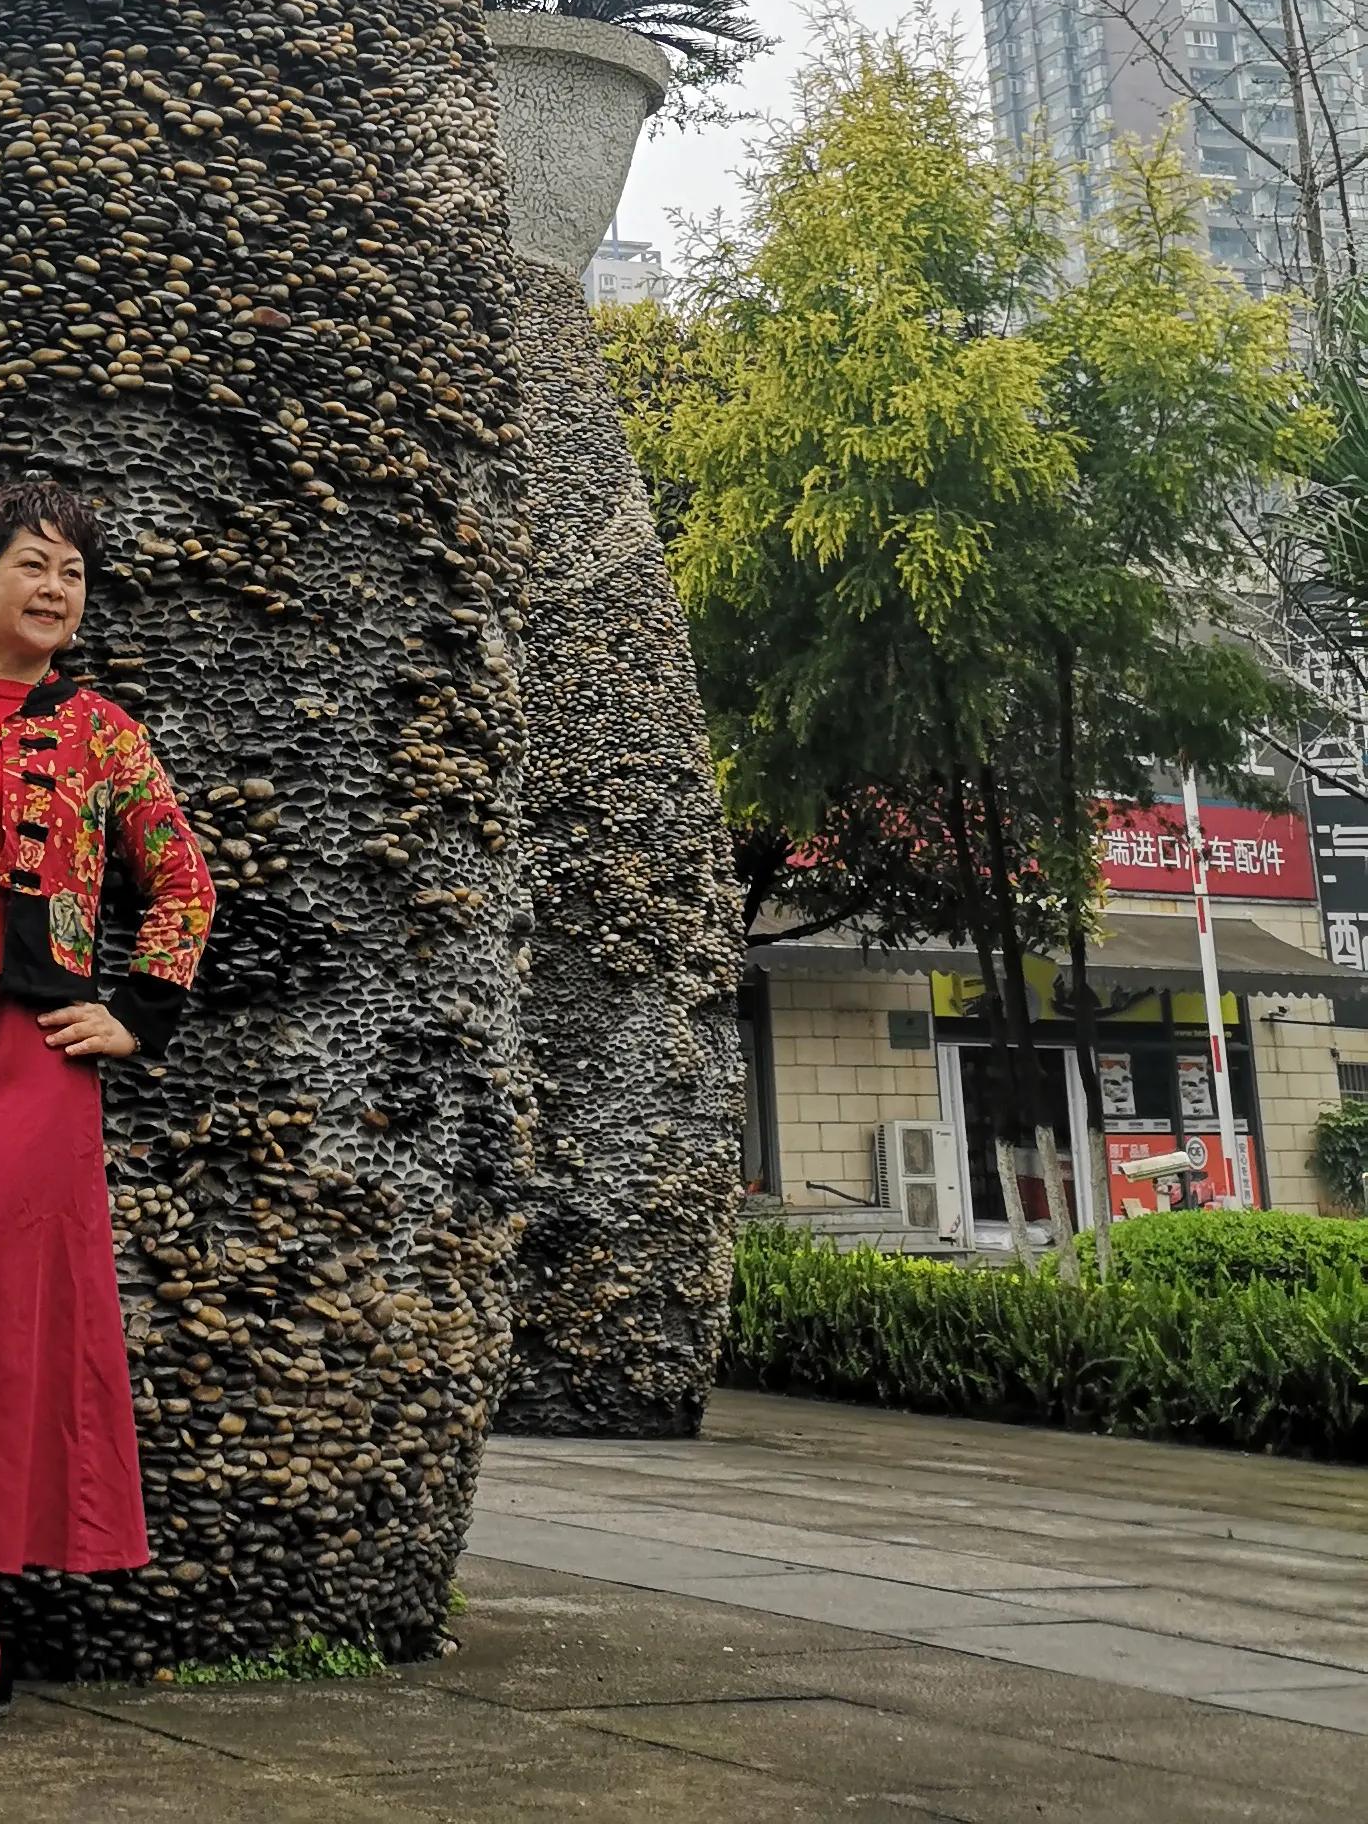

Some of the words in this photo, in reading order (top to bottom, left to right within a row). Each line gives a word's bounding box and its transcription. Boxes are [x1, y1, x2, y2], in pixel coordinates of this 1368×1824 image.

[1089, 828, 1286, 876] 端进口车配件
